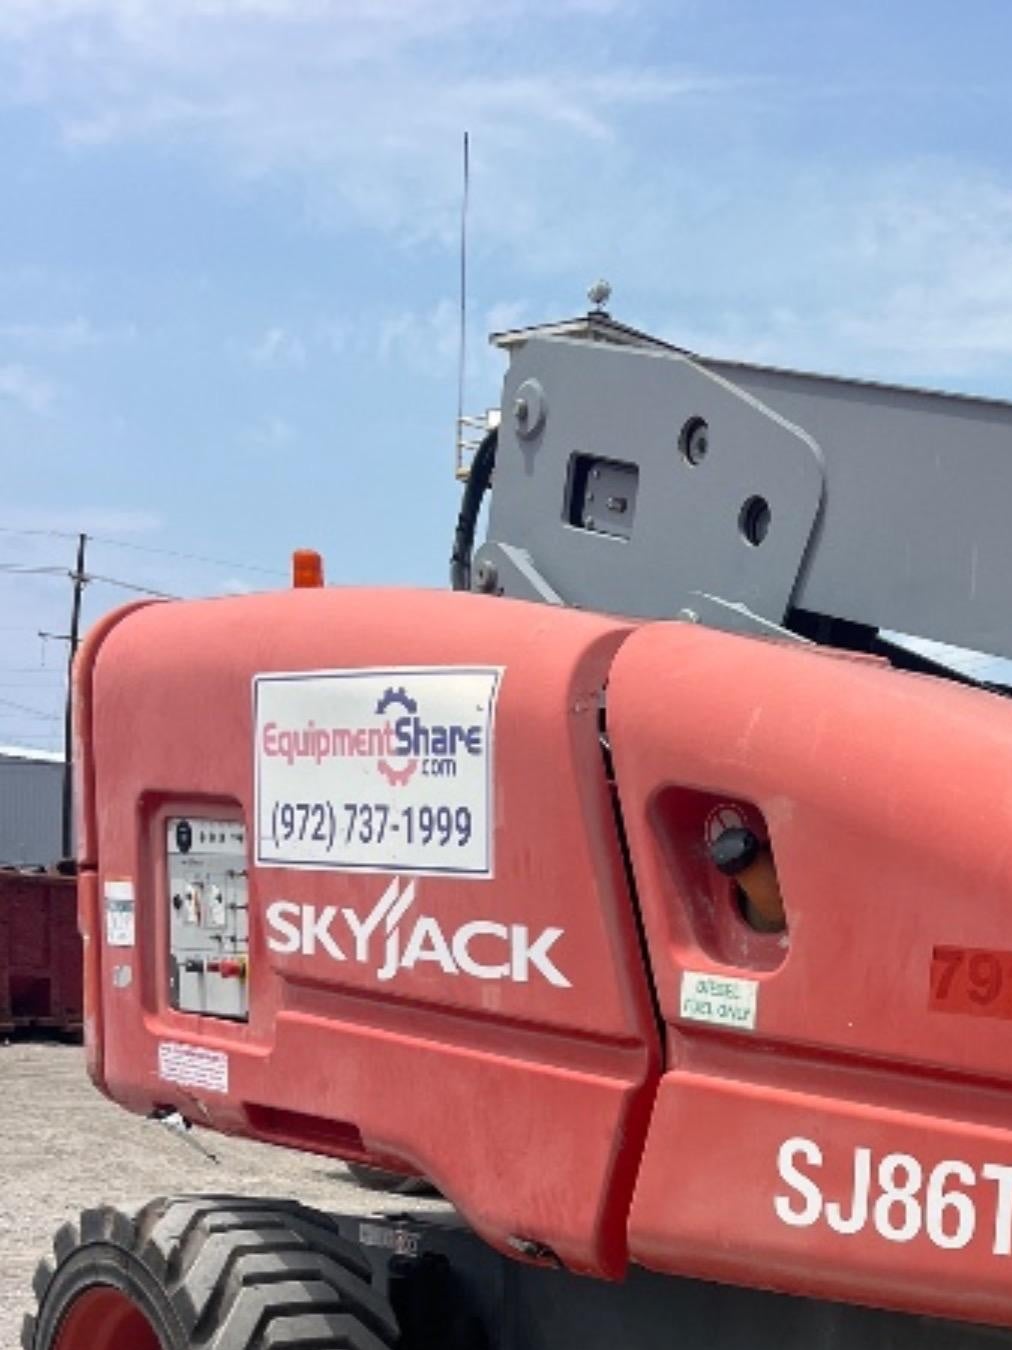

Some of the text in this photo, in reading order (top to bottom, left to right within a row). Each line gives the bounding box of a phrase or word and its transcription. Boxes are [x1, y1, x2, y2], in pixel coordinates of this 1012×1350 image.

[272, 801, 472, 852] (972) 737-1999
[265, 876, 572, 988] SKYJACK
